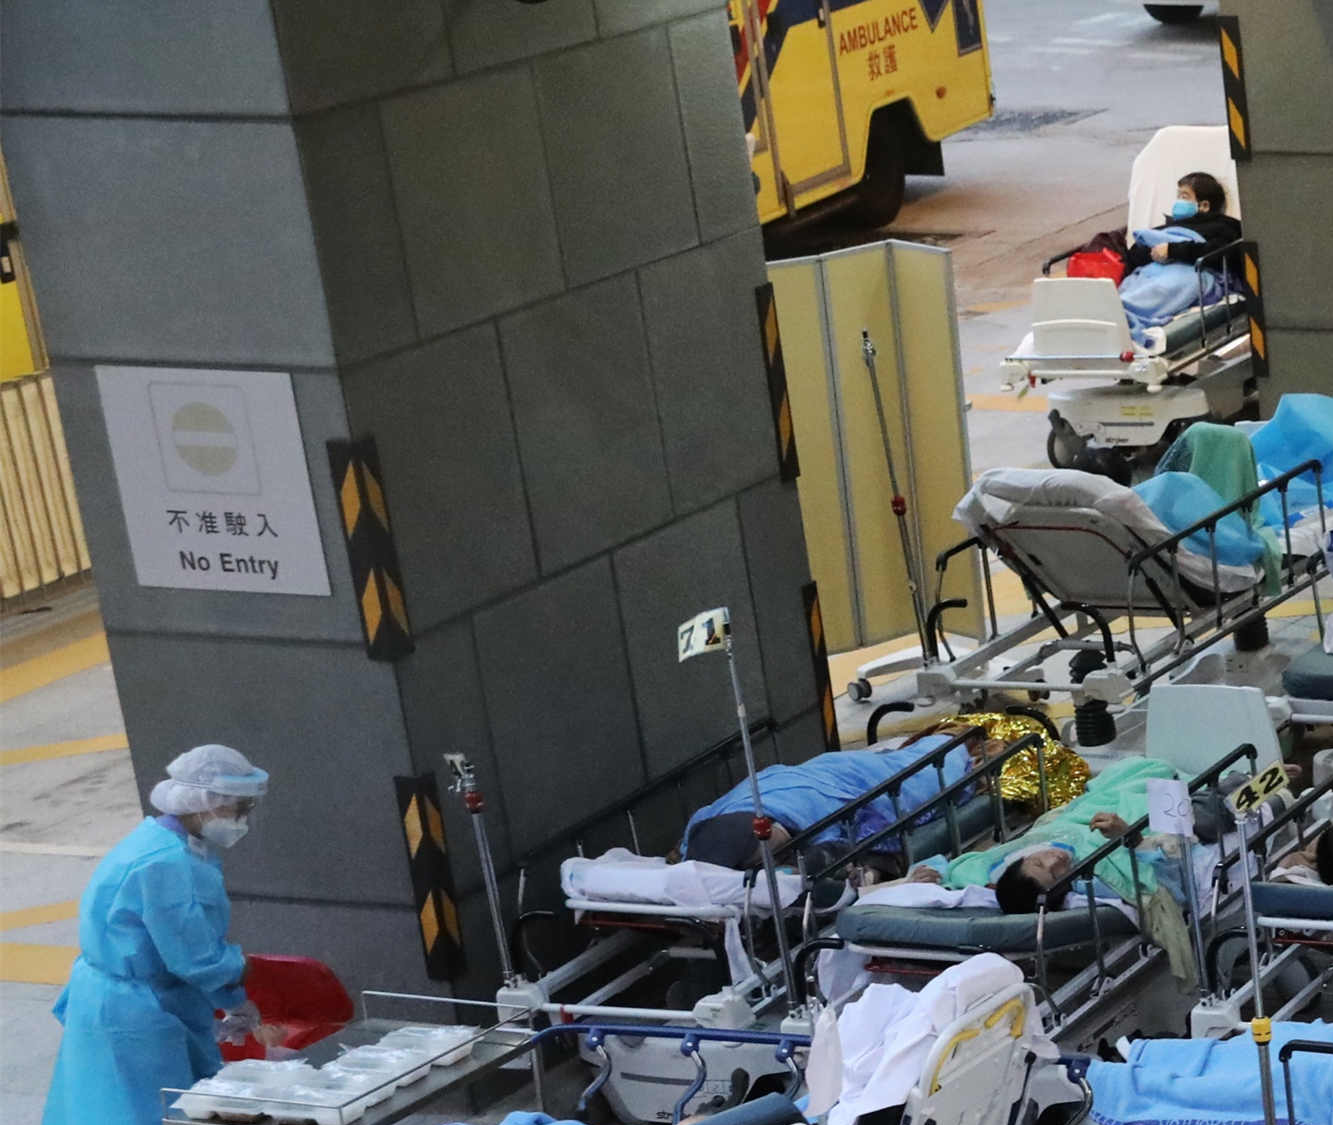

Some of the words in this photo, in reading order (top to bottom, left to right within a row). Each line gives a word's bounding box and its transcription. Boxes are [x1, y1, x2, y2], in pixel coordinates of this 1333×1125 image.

[839, 8, 918, 56] AMBULANCE
[867, 45, 898, 80] 救護
[166, 509, 279, 538] 不准駛入
[179, 550, 211, 571] No
[219, 552, 278, 580] Entry
[680, 616, 721, 655] 71
[1236, 766, 1284, 810] 42
